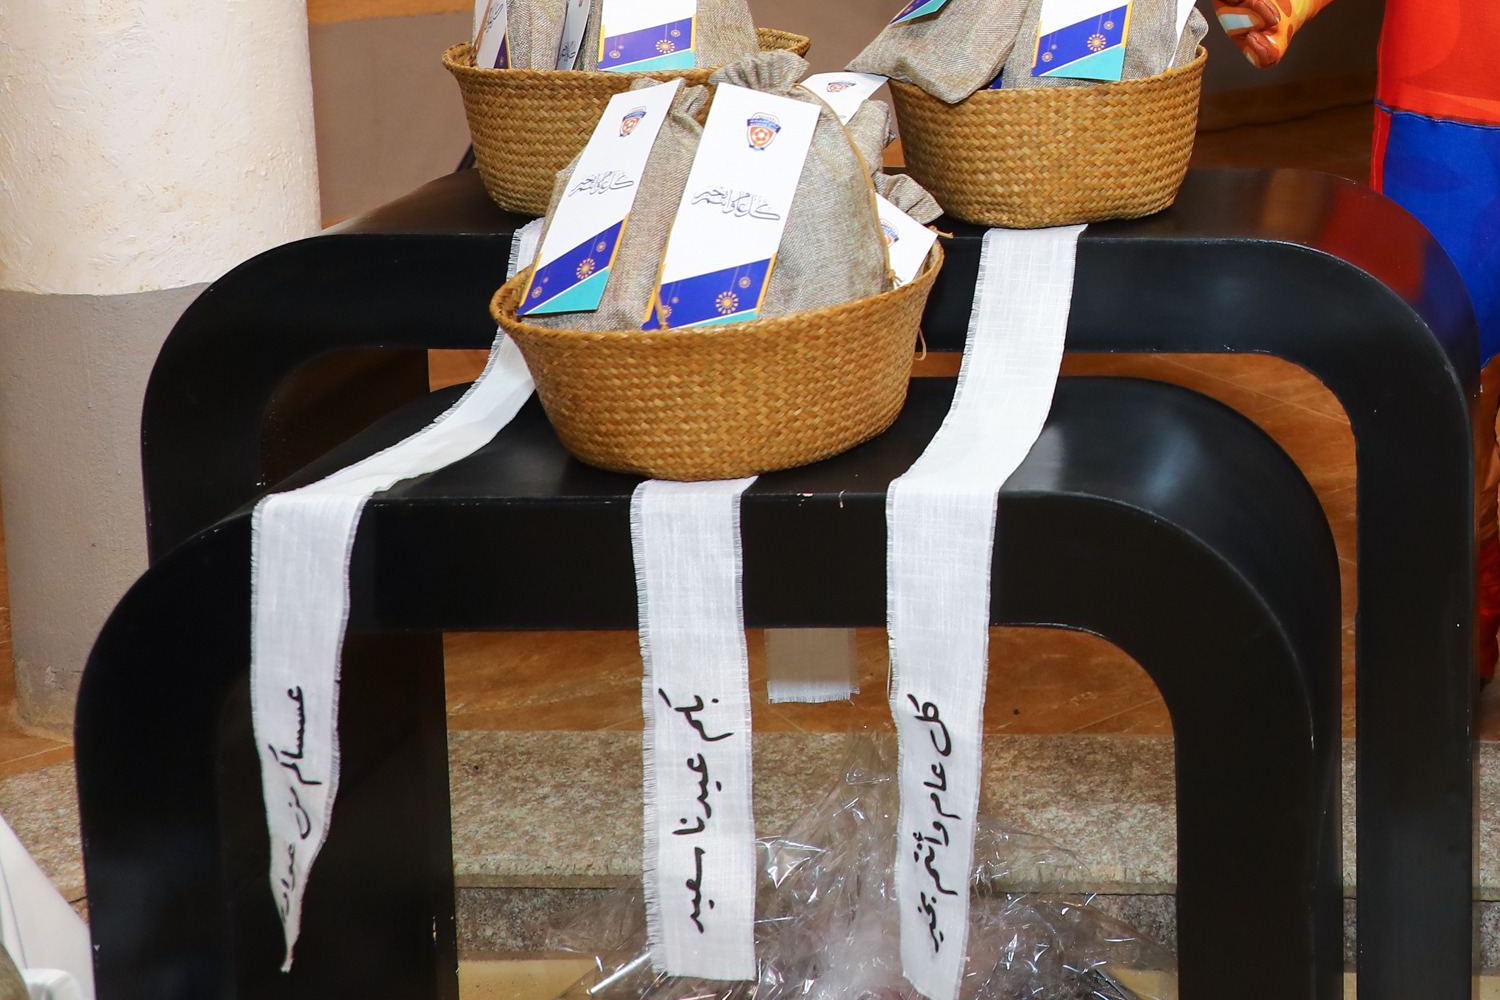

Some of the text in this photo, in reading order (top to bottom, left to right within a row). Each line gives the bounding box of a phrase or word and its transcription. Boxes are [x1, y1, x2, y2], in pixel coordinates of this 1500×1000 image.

[907, 693, 952, 757] كل
[658, 688, 734, 934] بكم عيدنا سعيد
[923, 762, 961, 820] عام
[917, 891, 945, 953] بخير
